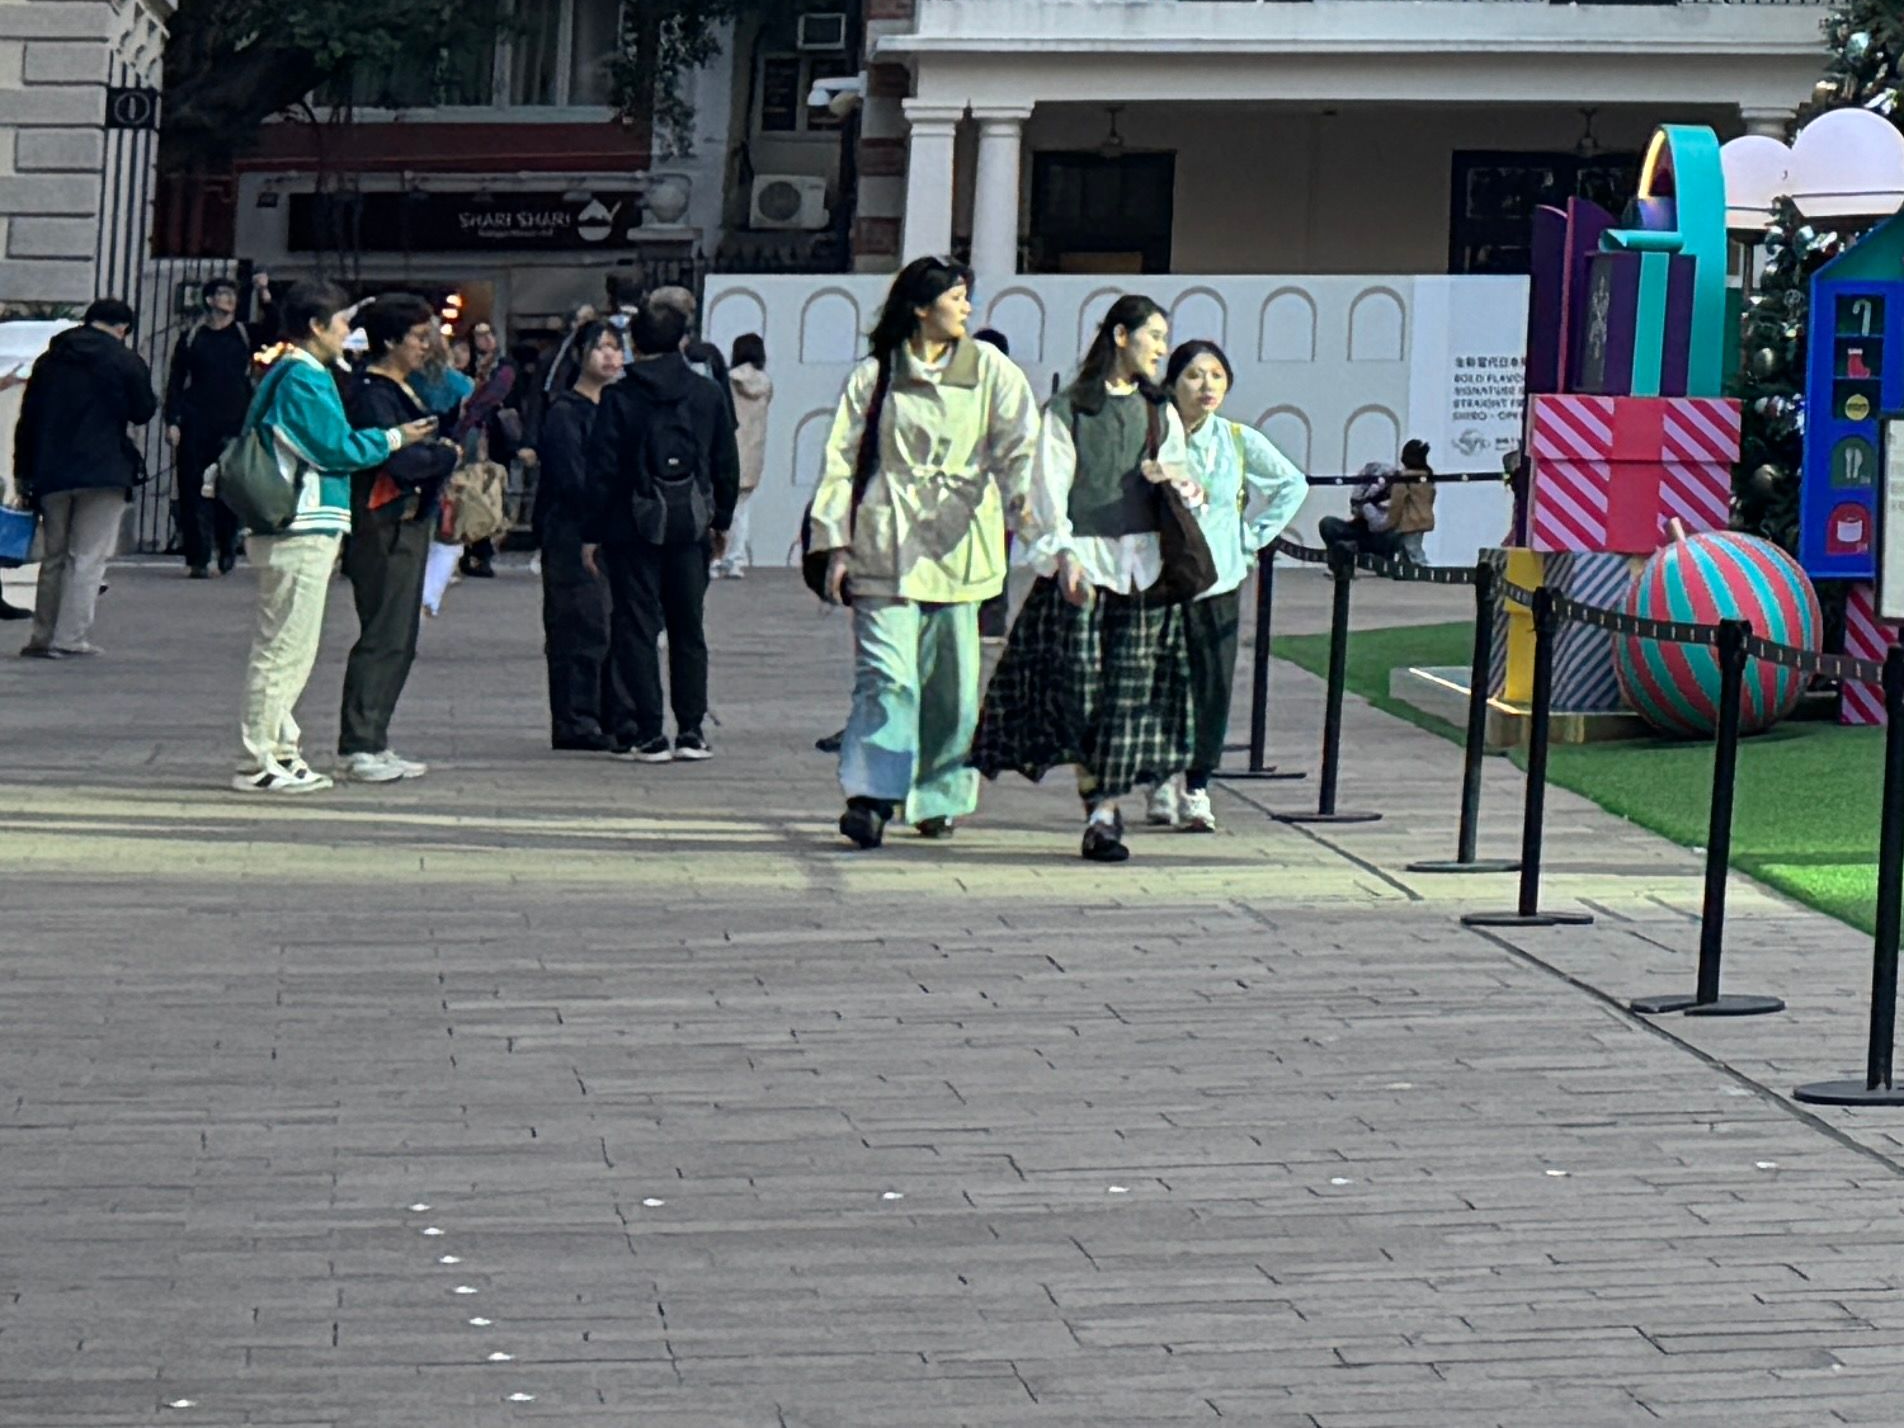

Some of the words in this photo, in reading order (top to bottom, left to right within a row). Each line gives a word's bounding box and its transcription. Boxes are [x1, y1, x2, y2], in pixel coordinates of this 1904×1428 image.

[458, 211, 512, 228] SHARI
[516, 211, 571, 228] SHARI
[1486, 373, 1525, 383] FLAVO
